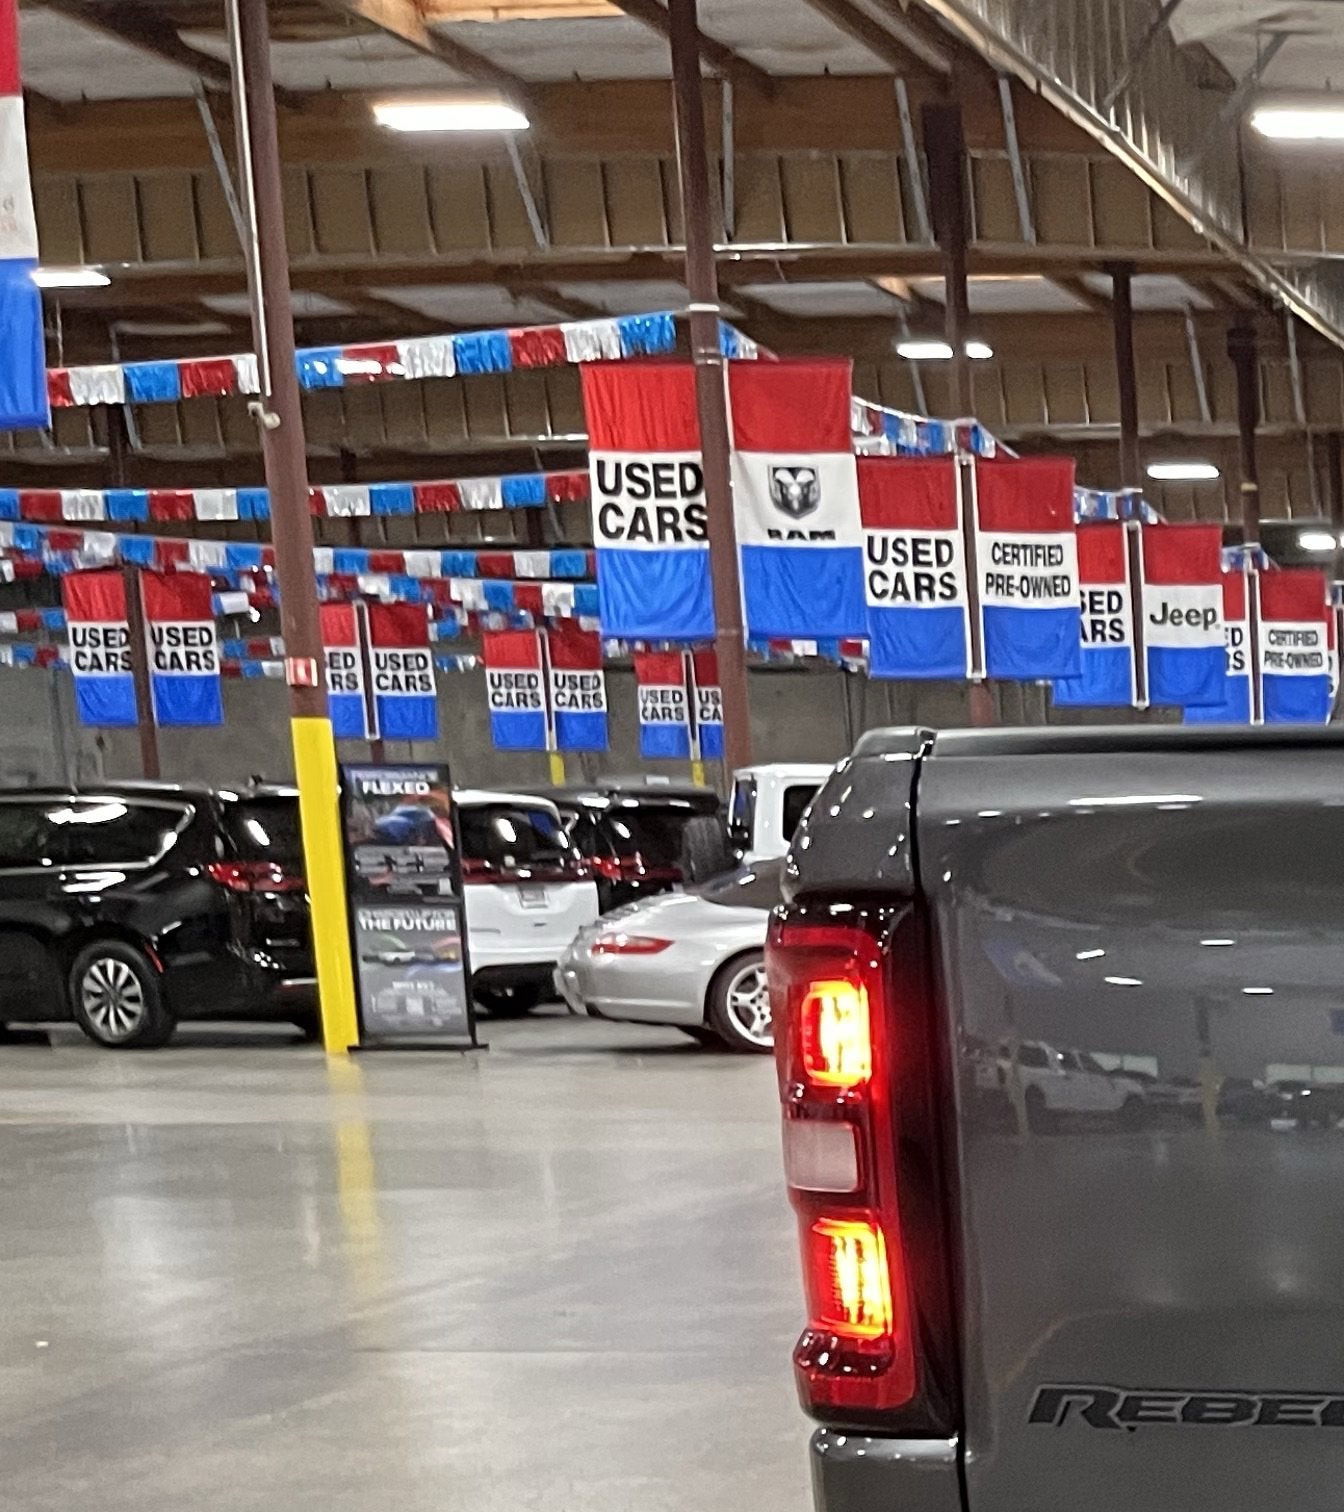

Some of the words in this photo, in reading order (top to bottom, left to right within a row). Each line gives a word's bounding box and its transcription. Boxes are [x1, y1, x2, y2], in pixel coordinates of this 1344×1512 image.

[596, 460, 704, 501] USED
[599, 502, 708, 543] CARS
[867, 535, 954, 568] USED
[991, 541, 1064, 567] CERTIFIED
[868, 569, 958, 601] CARS
[985, 572, 1071, 598] PRE-OWNED
[1149, 602, 1218, 630] Jeep
[71, 627, 129, 648] USED
[151, 626, 213, 648] USED
[74, 650, 132, 672] CARS
[155, 650, 215, 671] CARS
[328, 651, 356, 670] ED
[374, 652, 429, 672] USED
[1264, 651, 1323, 669] PRE-OWNED
[330, 672, 359, 692] RS
[375, 673, 432, 692] CARS
[489, 672, 539, 690] USED
[553, 672, 601, 691] USED
[491, 690, 541, 709] CARS
[555, 690, 604, 709] CARS
[641, 689, 683, 705] USED
[698, 689, 721, 705] US
[641, 706, 685, 722] CARS
[699, 708, 723, 722] CA
